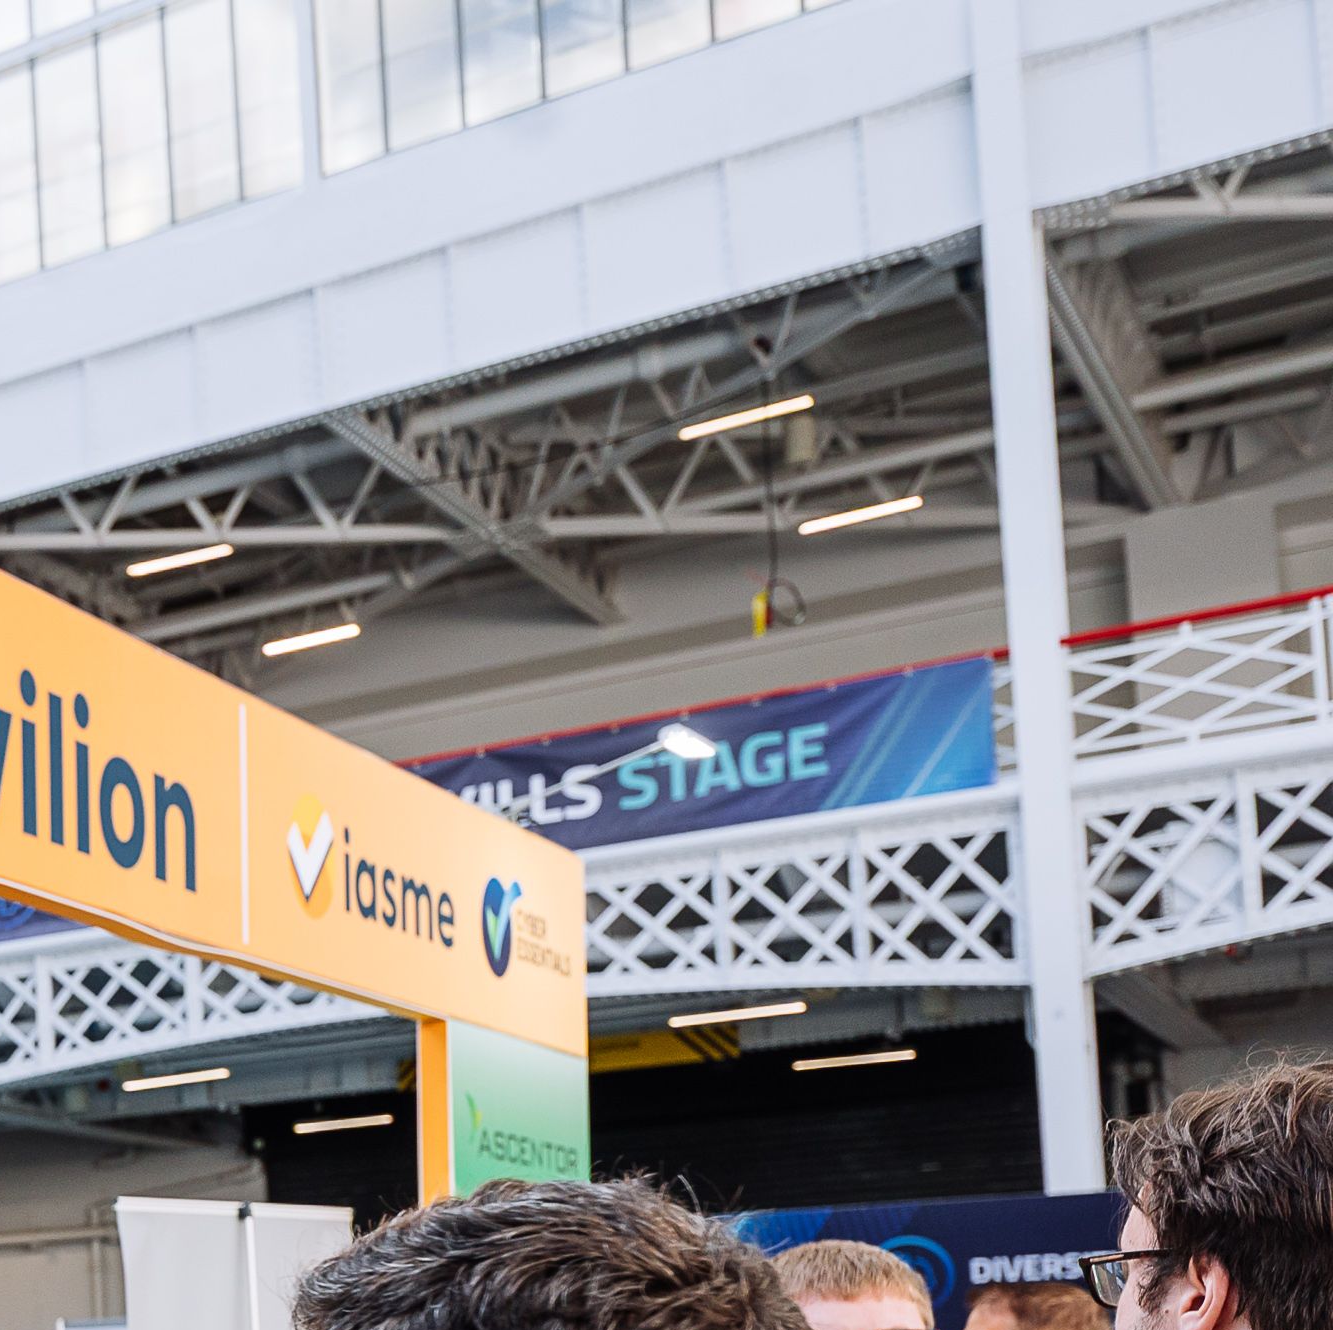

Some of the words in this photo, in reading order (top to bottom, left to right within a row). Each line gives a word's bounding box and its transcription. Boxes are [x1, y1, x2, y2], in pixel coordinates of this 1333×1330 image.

[460, 764, 603, 826] ILLS
[616, 721, 831, 812] STAGE
[344, 828, 455, 950] iasme
[517, 908, 547, 941] CYBER
[517, 937, 573, 978] ESSENTIALS
[479, 1128, 579, 1174] ASCENTOR
[968, 1251, 1121, 1285] DIVERS
